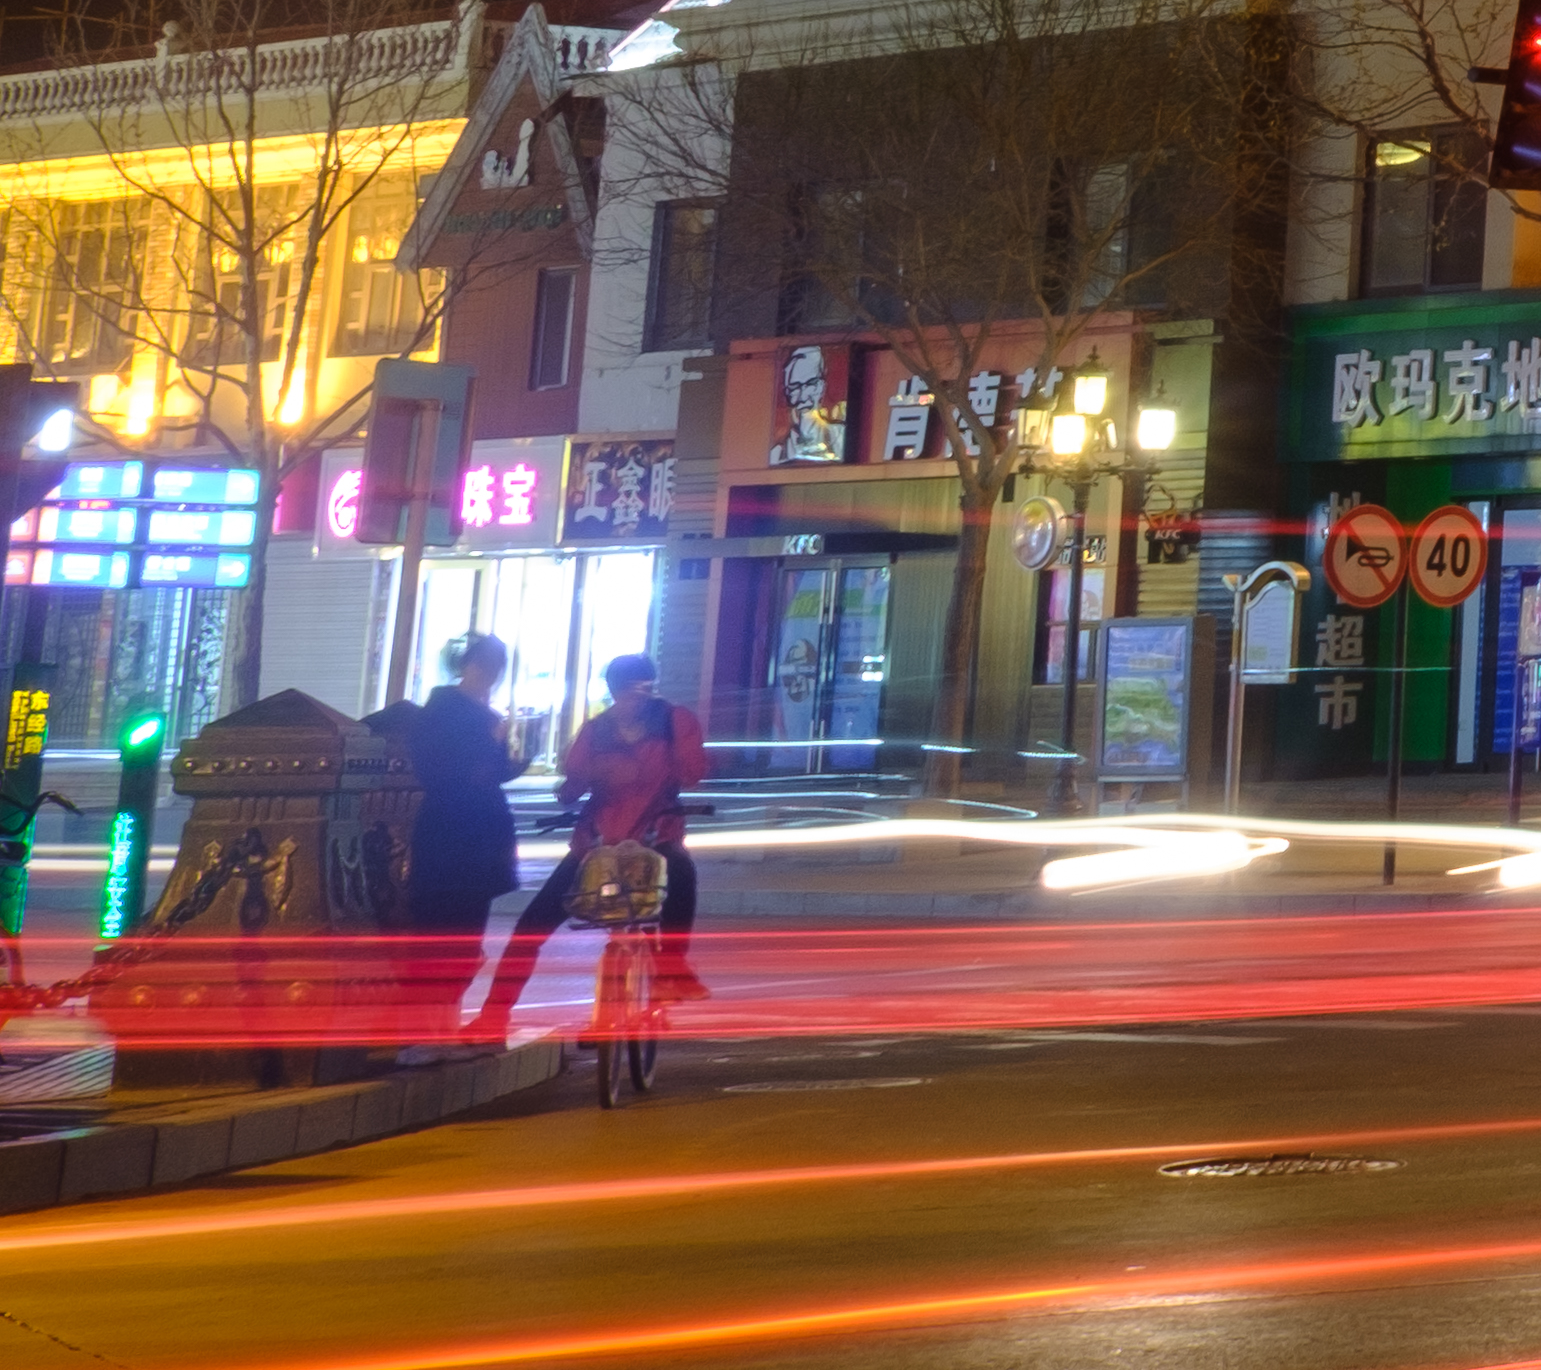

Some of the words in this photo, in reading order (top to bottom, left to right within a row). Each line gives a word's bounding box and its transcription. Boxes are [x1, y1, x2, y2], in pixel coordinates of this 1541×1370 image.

[461, 463, 536, 527] 珠宝
[782, 533, 823, 556] KFC
[1426, 533, 1471, 578] 40
